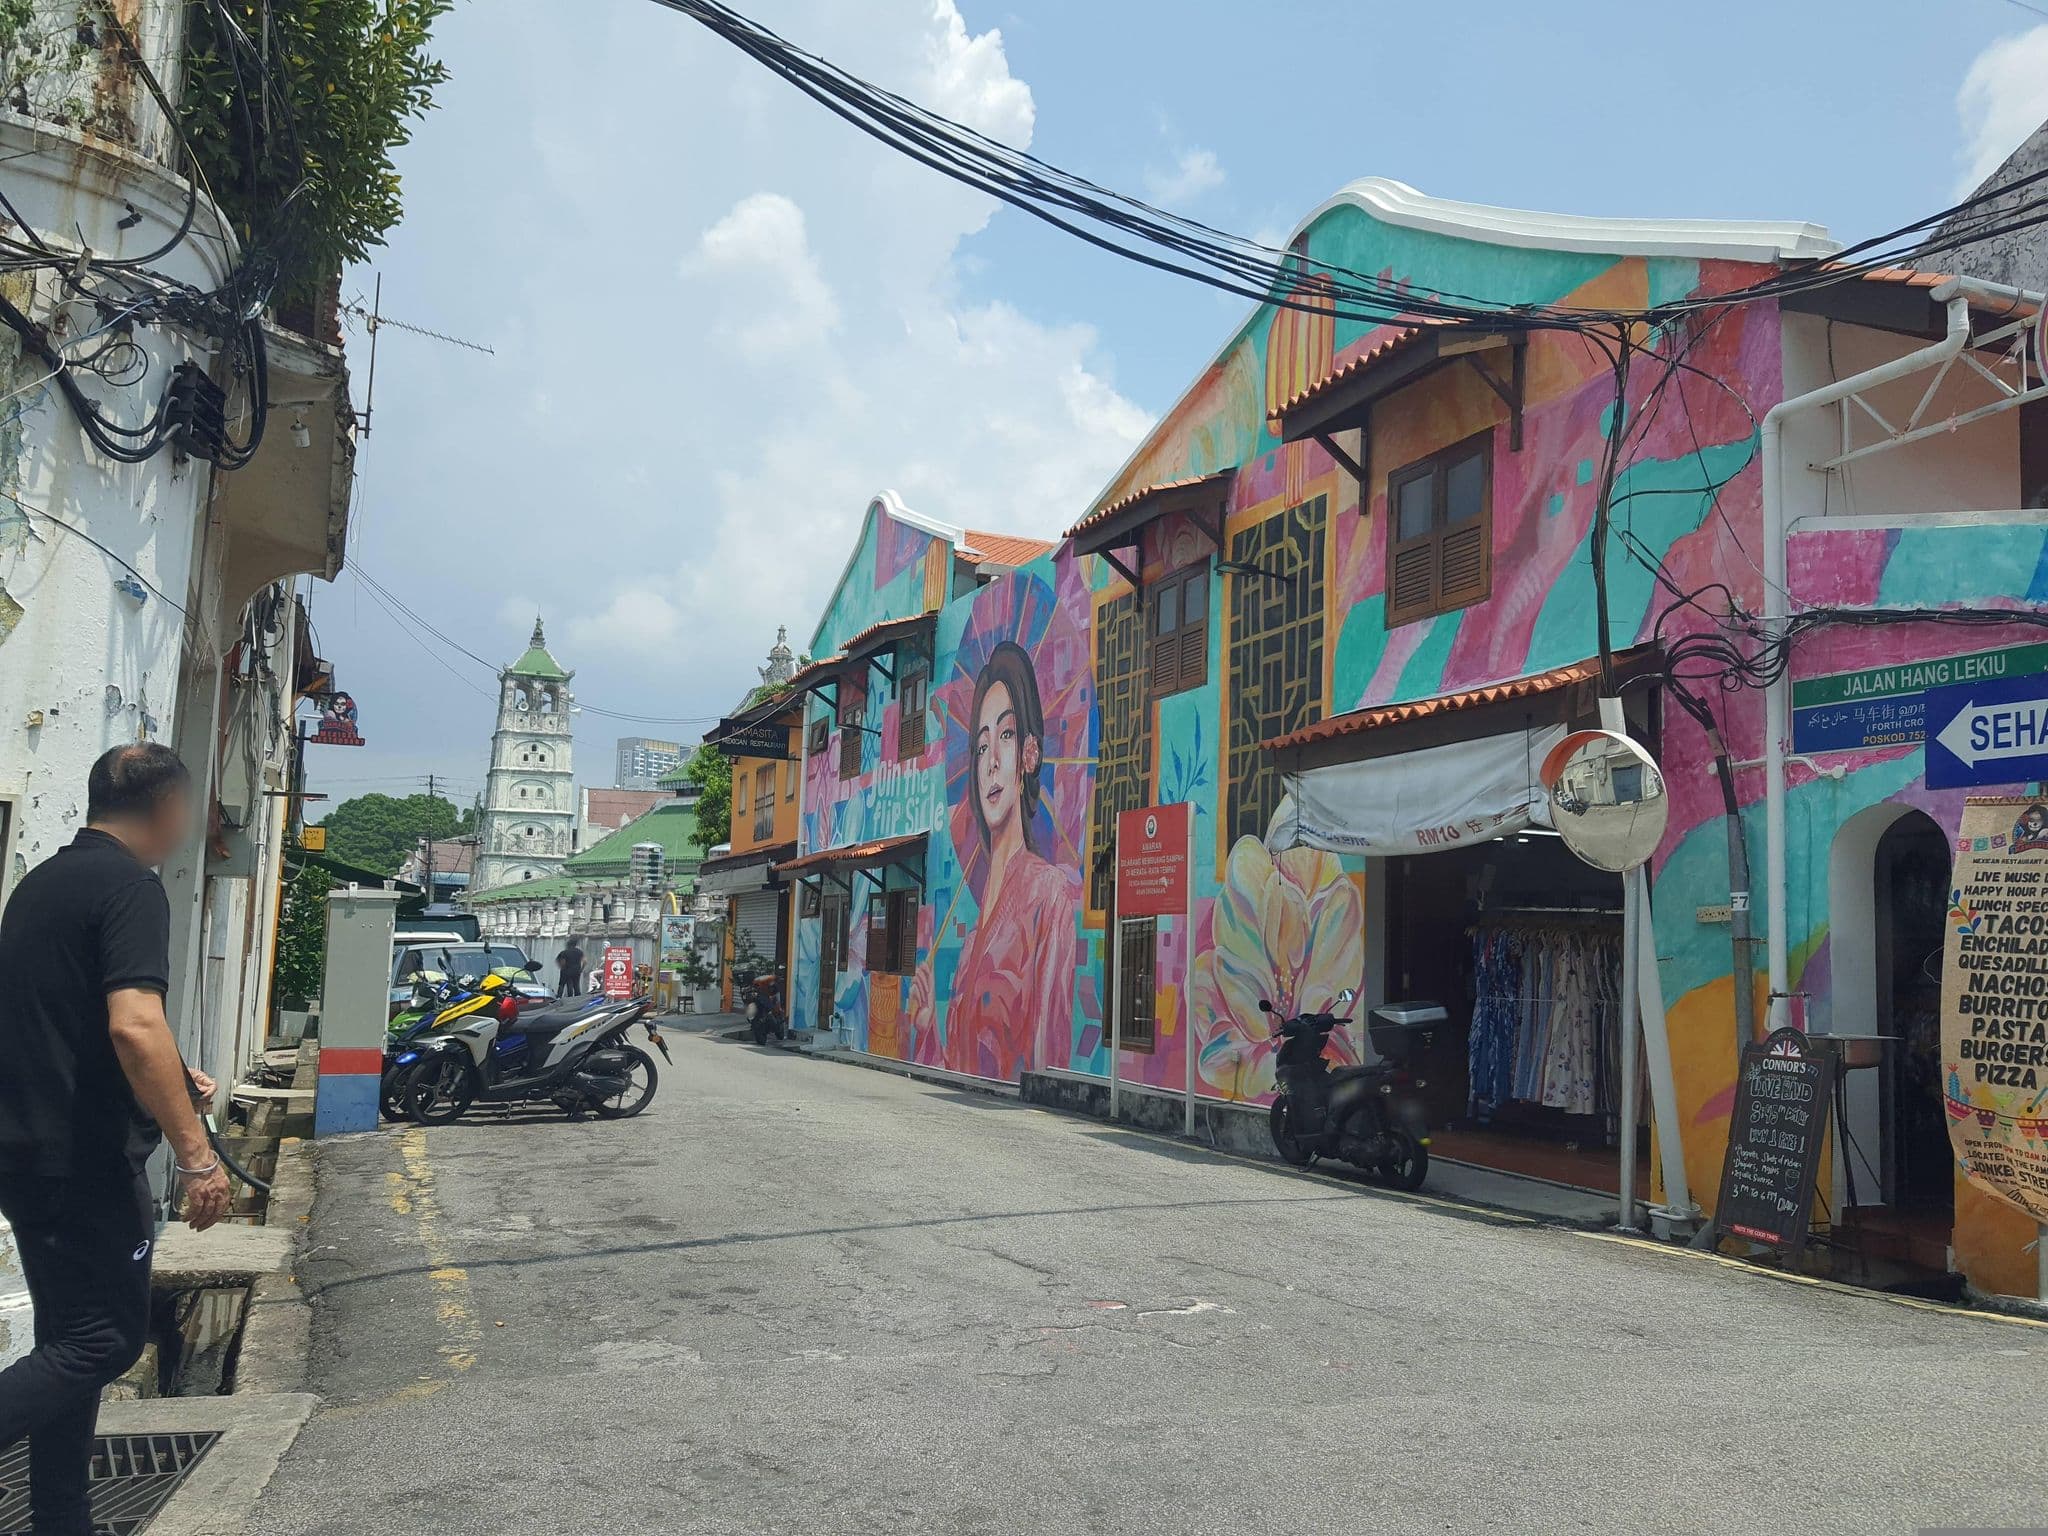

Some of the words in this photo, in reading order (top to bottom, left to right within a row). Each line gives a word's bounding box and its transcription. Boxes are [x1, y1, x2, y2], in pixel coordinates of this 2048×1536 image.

[1842, 671, 1896, 697] JALAN
[1900, 663, 1950, 688] HANG
[1954, 654, 2007, 681] LEKIU
[1862, 732, 1906, 745] POSKOD
[1416, 825, 1461, 847] RM10
[1974, 871, 2001, 882] LIVE
[2004, 872, 2041, 883] MUSIC
[1964, 885, 2003, 896] HAPPY
[2006, 886, 2036, 897] HOUR
[1968, 899, 2012, 911] LUNCH
[1984, 914, 2048, 935] TACO
[1968, 972, 2048, 997] NACHO
[1972, 1018, 2046, 1043] PASTA
[1960, 1039, 2048, 1067] BURGER
[1762, 1058, 1807, 1074] CONNOR'S
[1975, 1062, 2038, 1090] PIZZA
